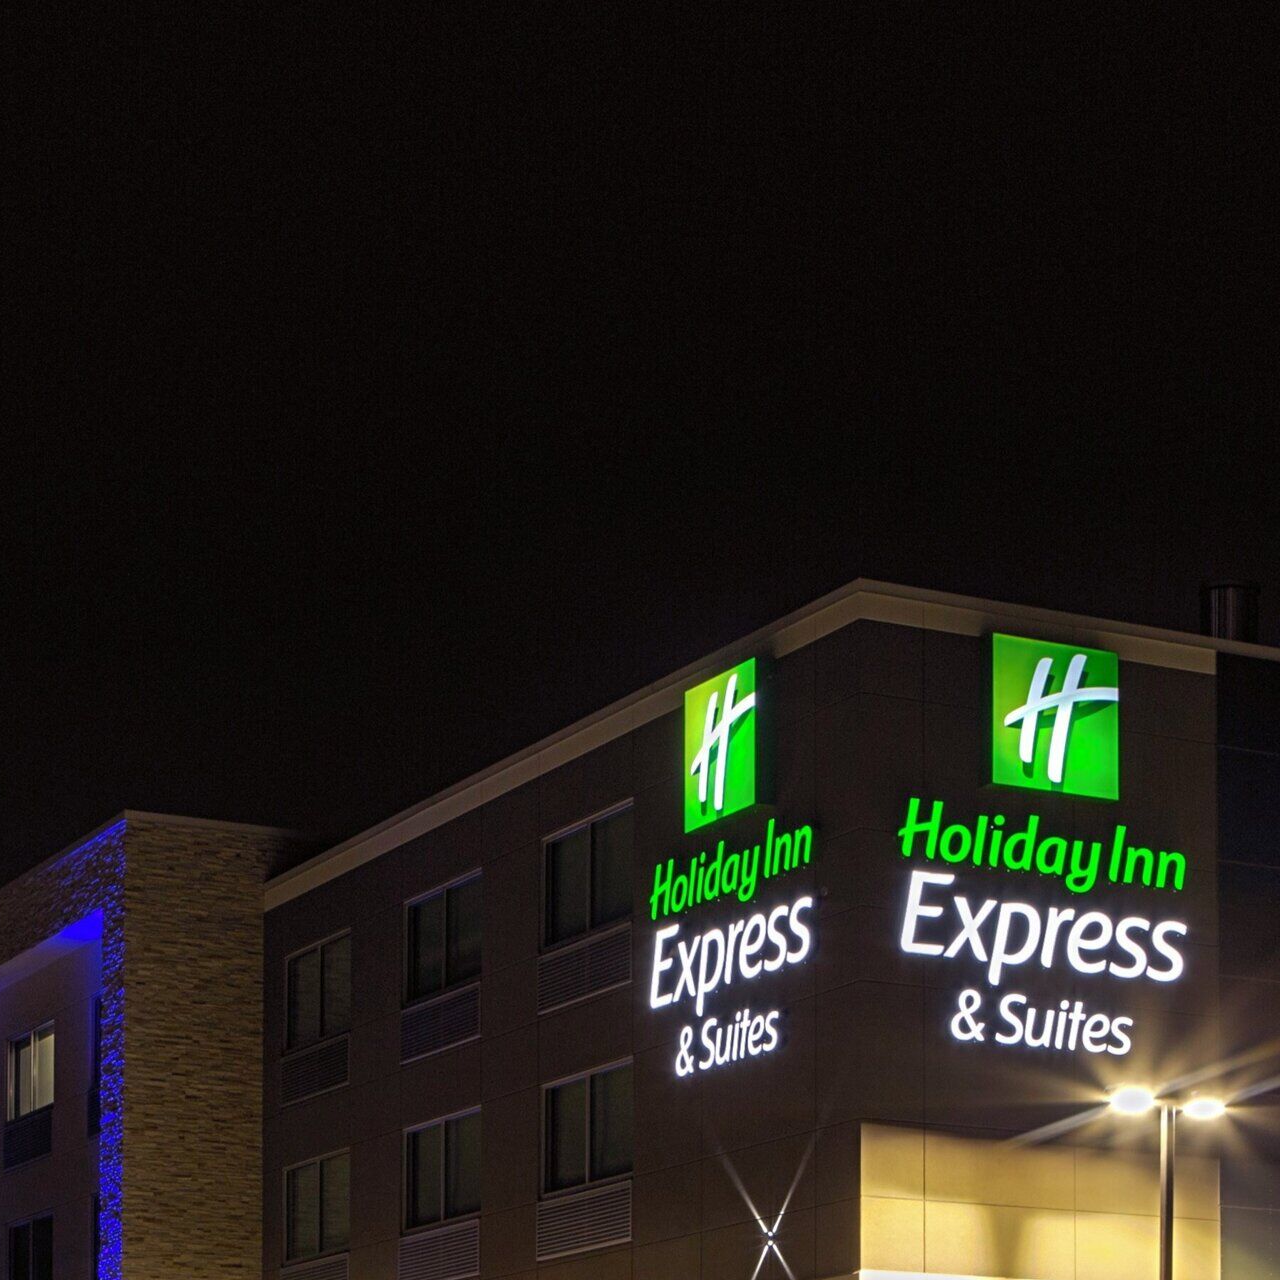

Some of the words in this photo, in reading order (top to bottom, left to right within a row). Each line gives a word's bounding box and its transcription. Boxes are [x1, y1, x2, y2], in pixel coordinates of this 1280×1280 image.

[649, 841, 760, 921] Holiday
[764, 818, 812, 879] Inn
[898, 797, 1102, 894] Holiday
[1108, 825, 1186, 891] Inn
[648, 896, 813, 1017] Express
[899, 869, 1188, 987] Express
[674, 1025, 695, 1077] &
[698, 1009, 780, 1071] Suites
[950, 988, 986, 1042] &
[994, 993, 1135, 1056] Suites
